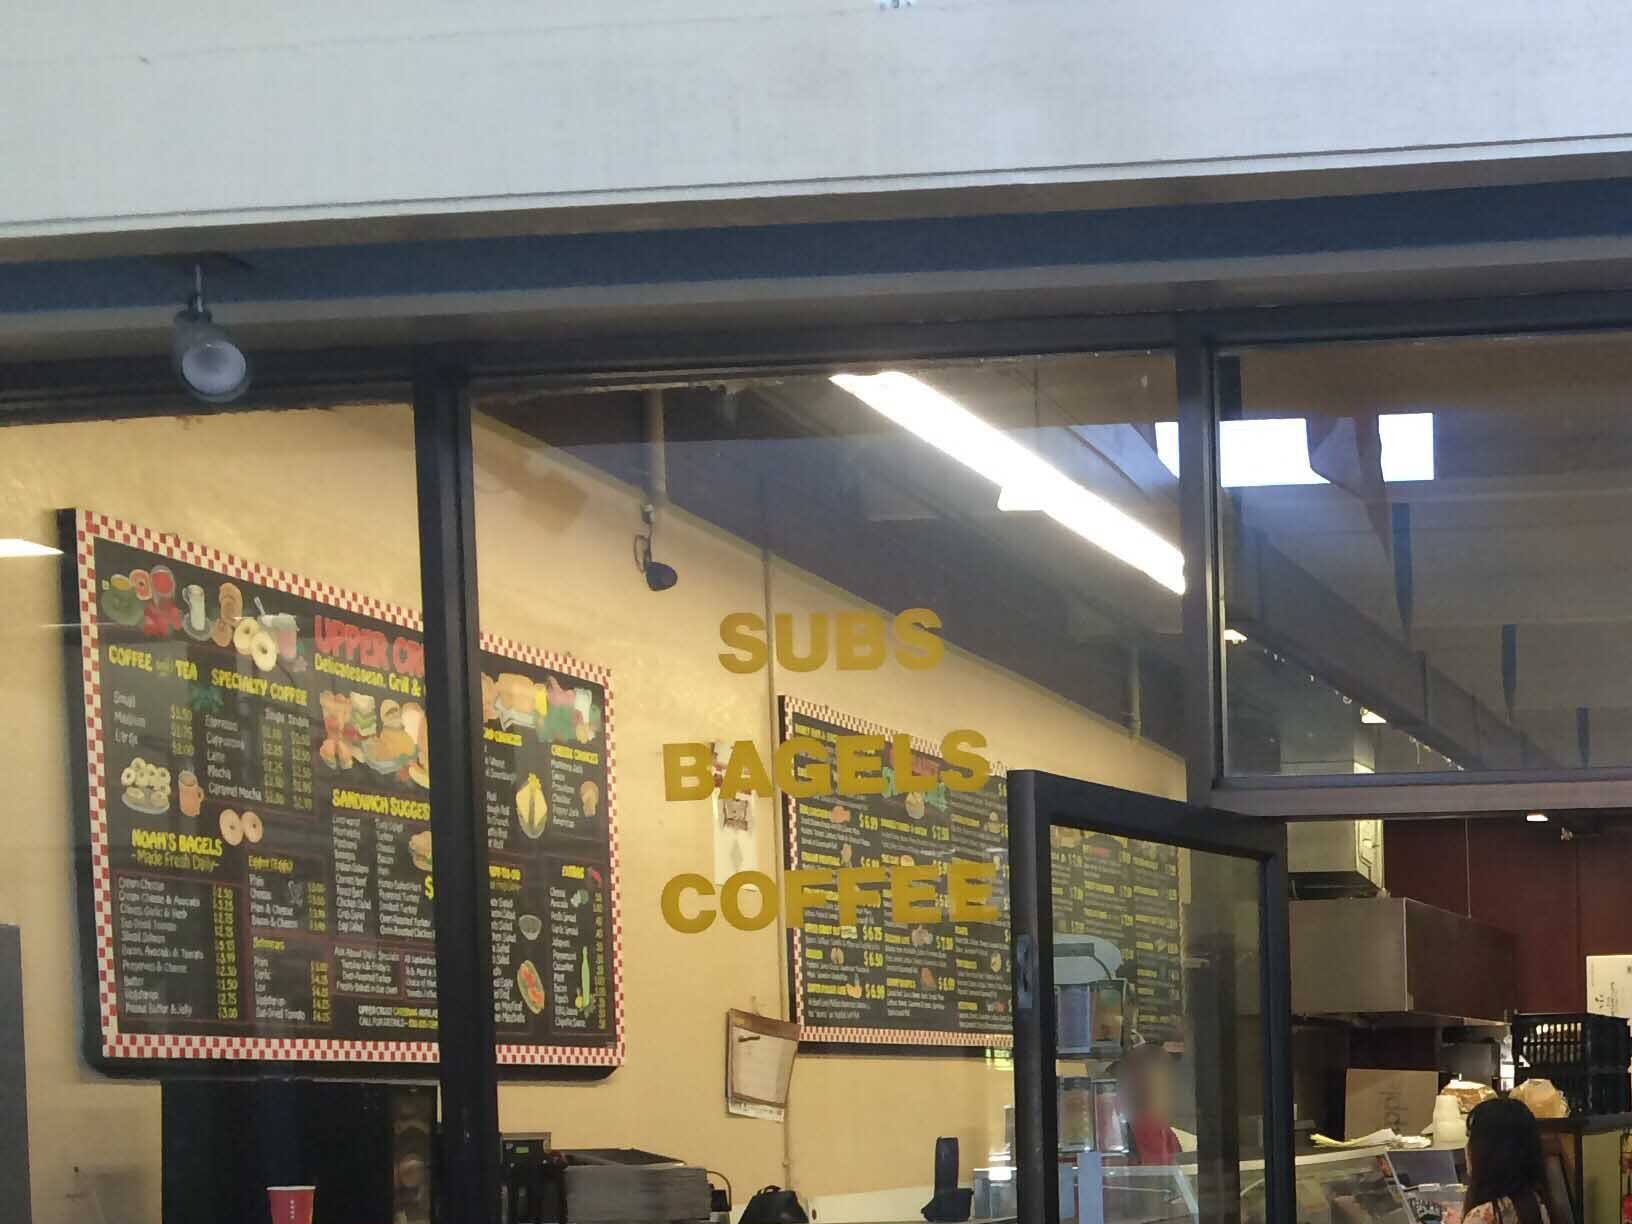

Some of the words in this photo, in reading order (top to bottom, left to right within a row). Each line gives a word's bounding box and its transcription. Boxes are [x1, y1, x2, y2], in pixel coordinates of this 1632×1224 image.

[108, 645, 152, 672] COFFEE
[176, 659, 198, 680] TEA
[314, 614, 390, 672] UPPER
[718, 608, 945, 674] SUBS
[212, 668, 267, 696] SPECIALTY
[270, 683, 308, 705] COFFEE
[663, 729, 992, 802] BAGELS
[332, 788, 389, 815] SANDWICH
[131, 829, 176, 851] NOAH'S
[179, 835, 223, 857] BAGELS
[661, 862, 998, 934] COFFEE
